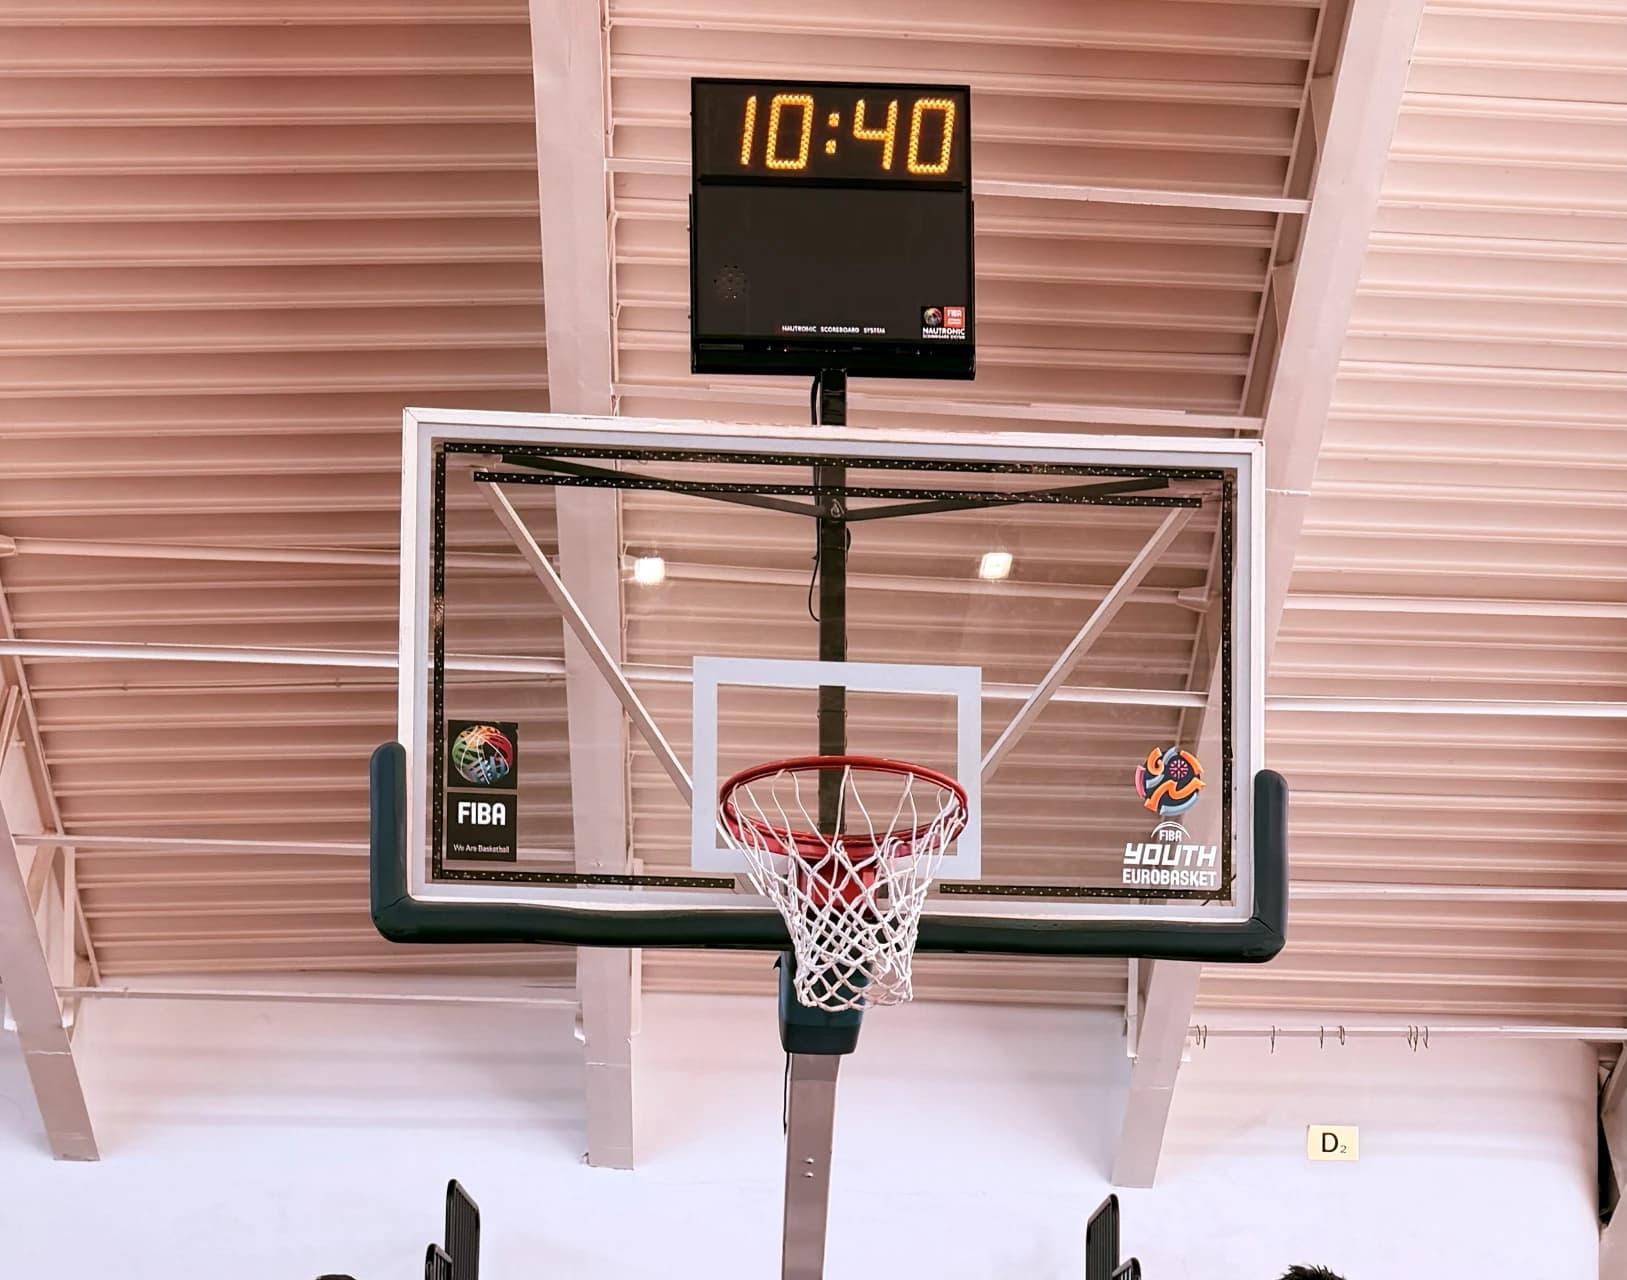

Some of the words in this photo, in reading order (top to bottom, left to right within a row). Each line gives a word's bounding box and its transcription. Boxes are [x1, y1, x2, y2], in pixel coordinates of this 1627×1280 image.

[740, 93, 956, 174] 10:40
[922, 327, 966, 336] NAUTRONIC
[457, 801, 506, 826] FIBA
[1159, 830, 1182, 841] FIBA
[453, 843, 464, 852] We
[465, 844, 477, 852] Are
[478, 844, 510, 854] Basketball
[1123, 843, 1217, 867] YOUTH
[1122, 868, 1217, 887] EUROBASKET
